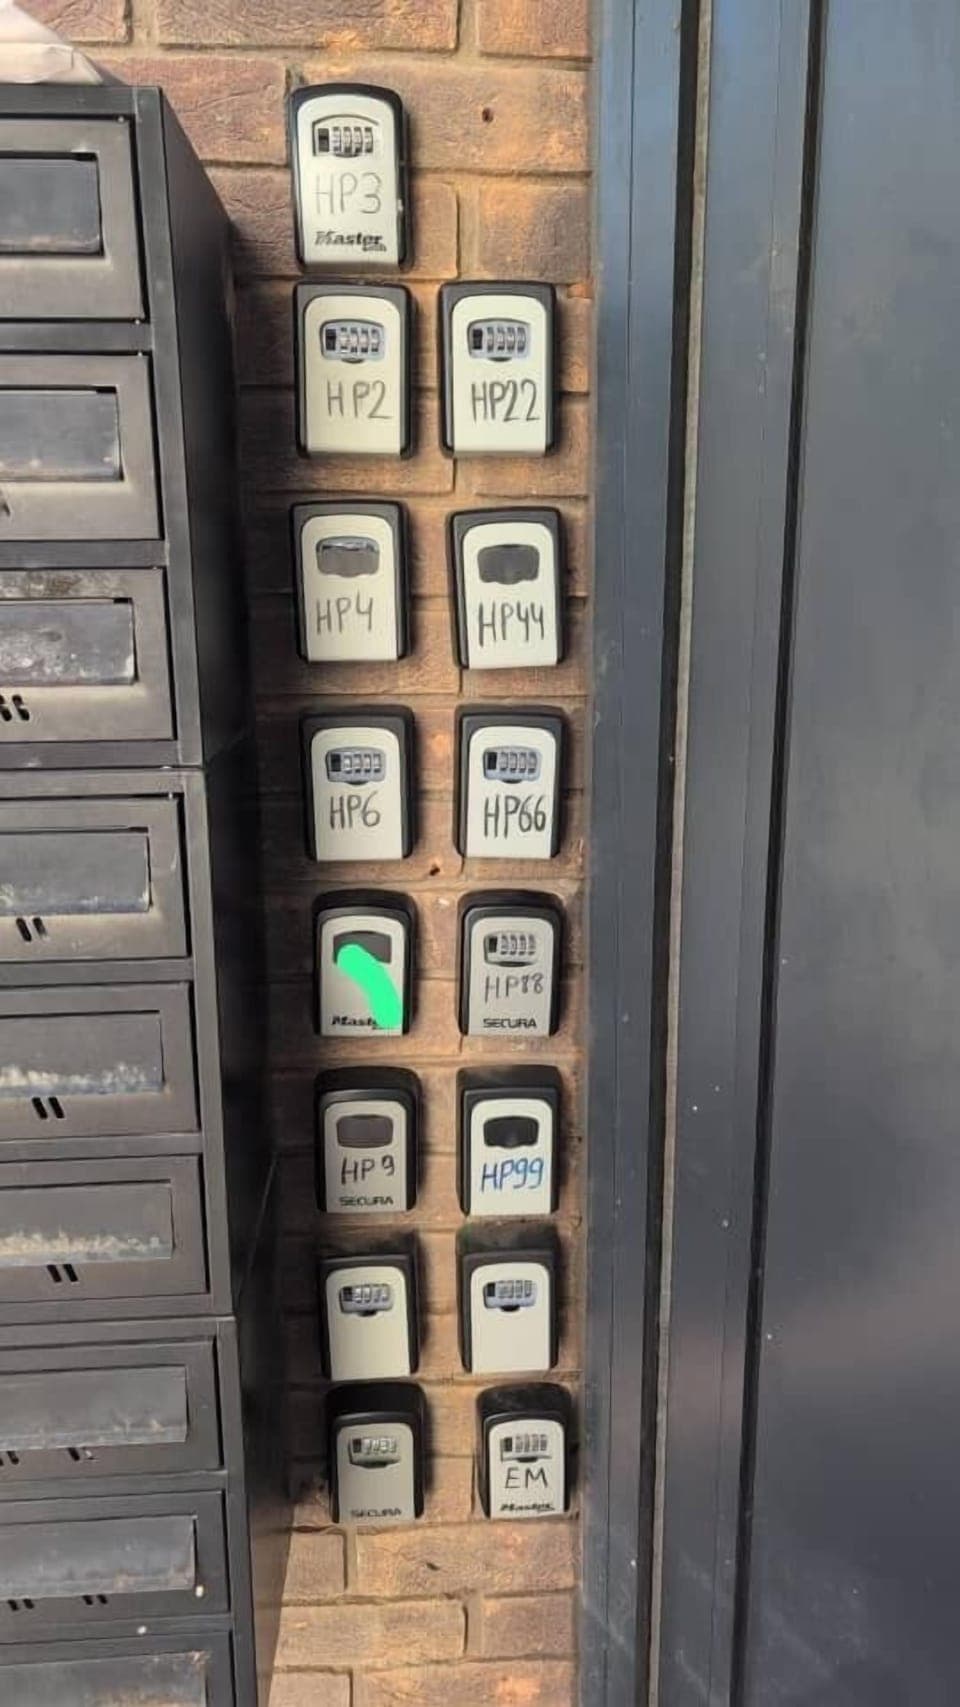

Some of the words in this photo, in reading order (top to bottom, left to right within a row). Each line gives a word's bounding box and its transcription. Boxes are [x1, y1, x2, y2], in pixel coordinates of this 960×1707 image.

[315, 172, 382, 216] HP3
[315, 231, 383, 246] Master
[326, 379, 393, 419] HP2
[470, 379, 540, 422] HP22
[316, 591, 375, 635] HP4
[478, 602, 545, 647] HP44
[329, 790, 381, 829] HP6
[483, 793, 547, 839] HP66
[484, 972, 545, 1003] HP88
[331, 1016, 380, 1027] Mast
[483, 1018, 538, 1029] SECURA
[481, 1157, 544, 1192] HP99
[339, 1195, 394, 1207] SECURA
[504, 1467, 548, 1489] EM
